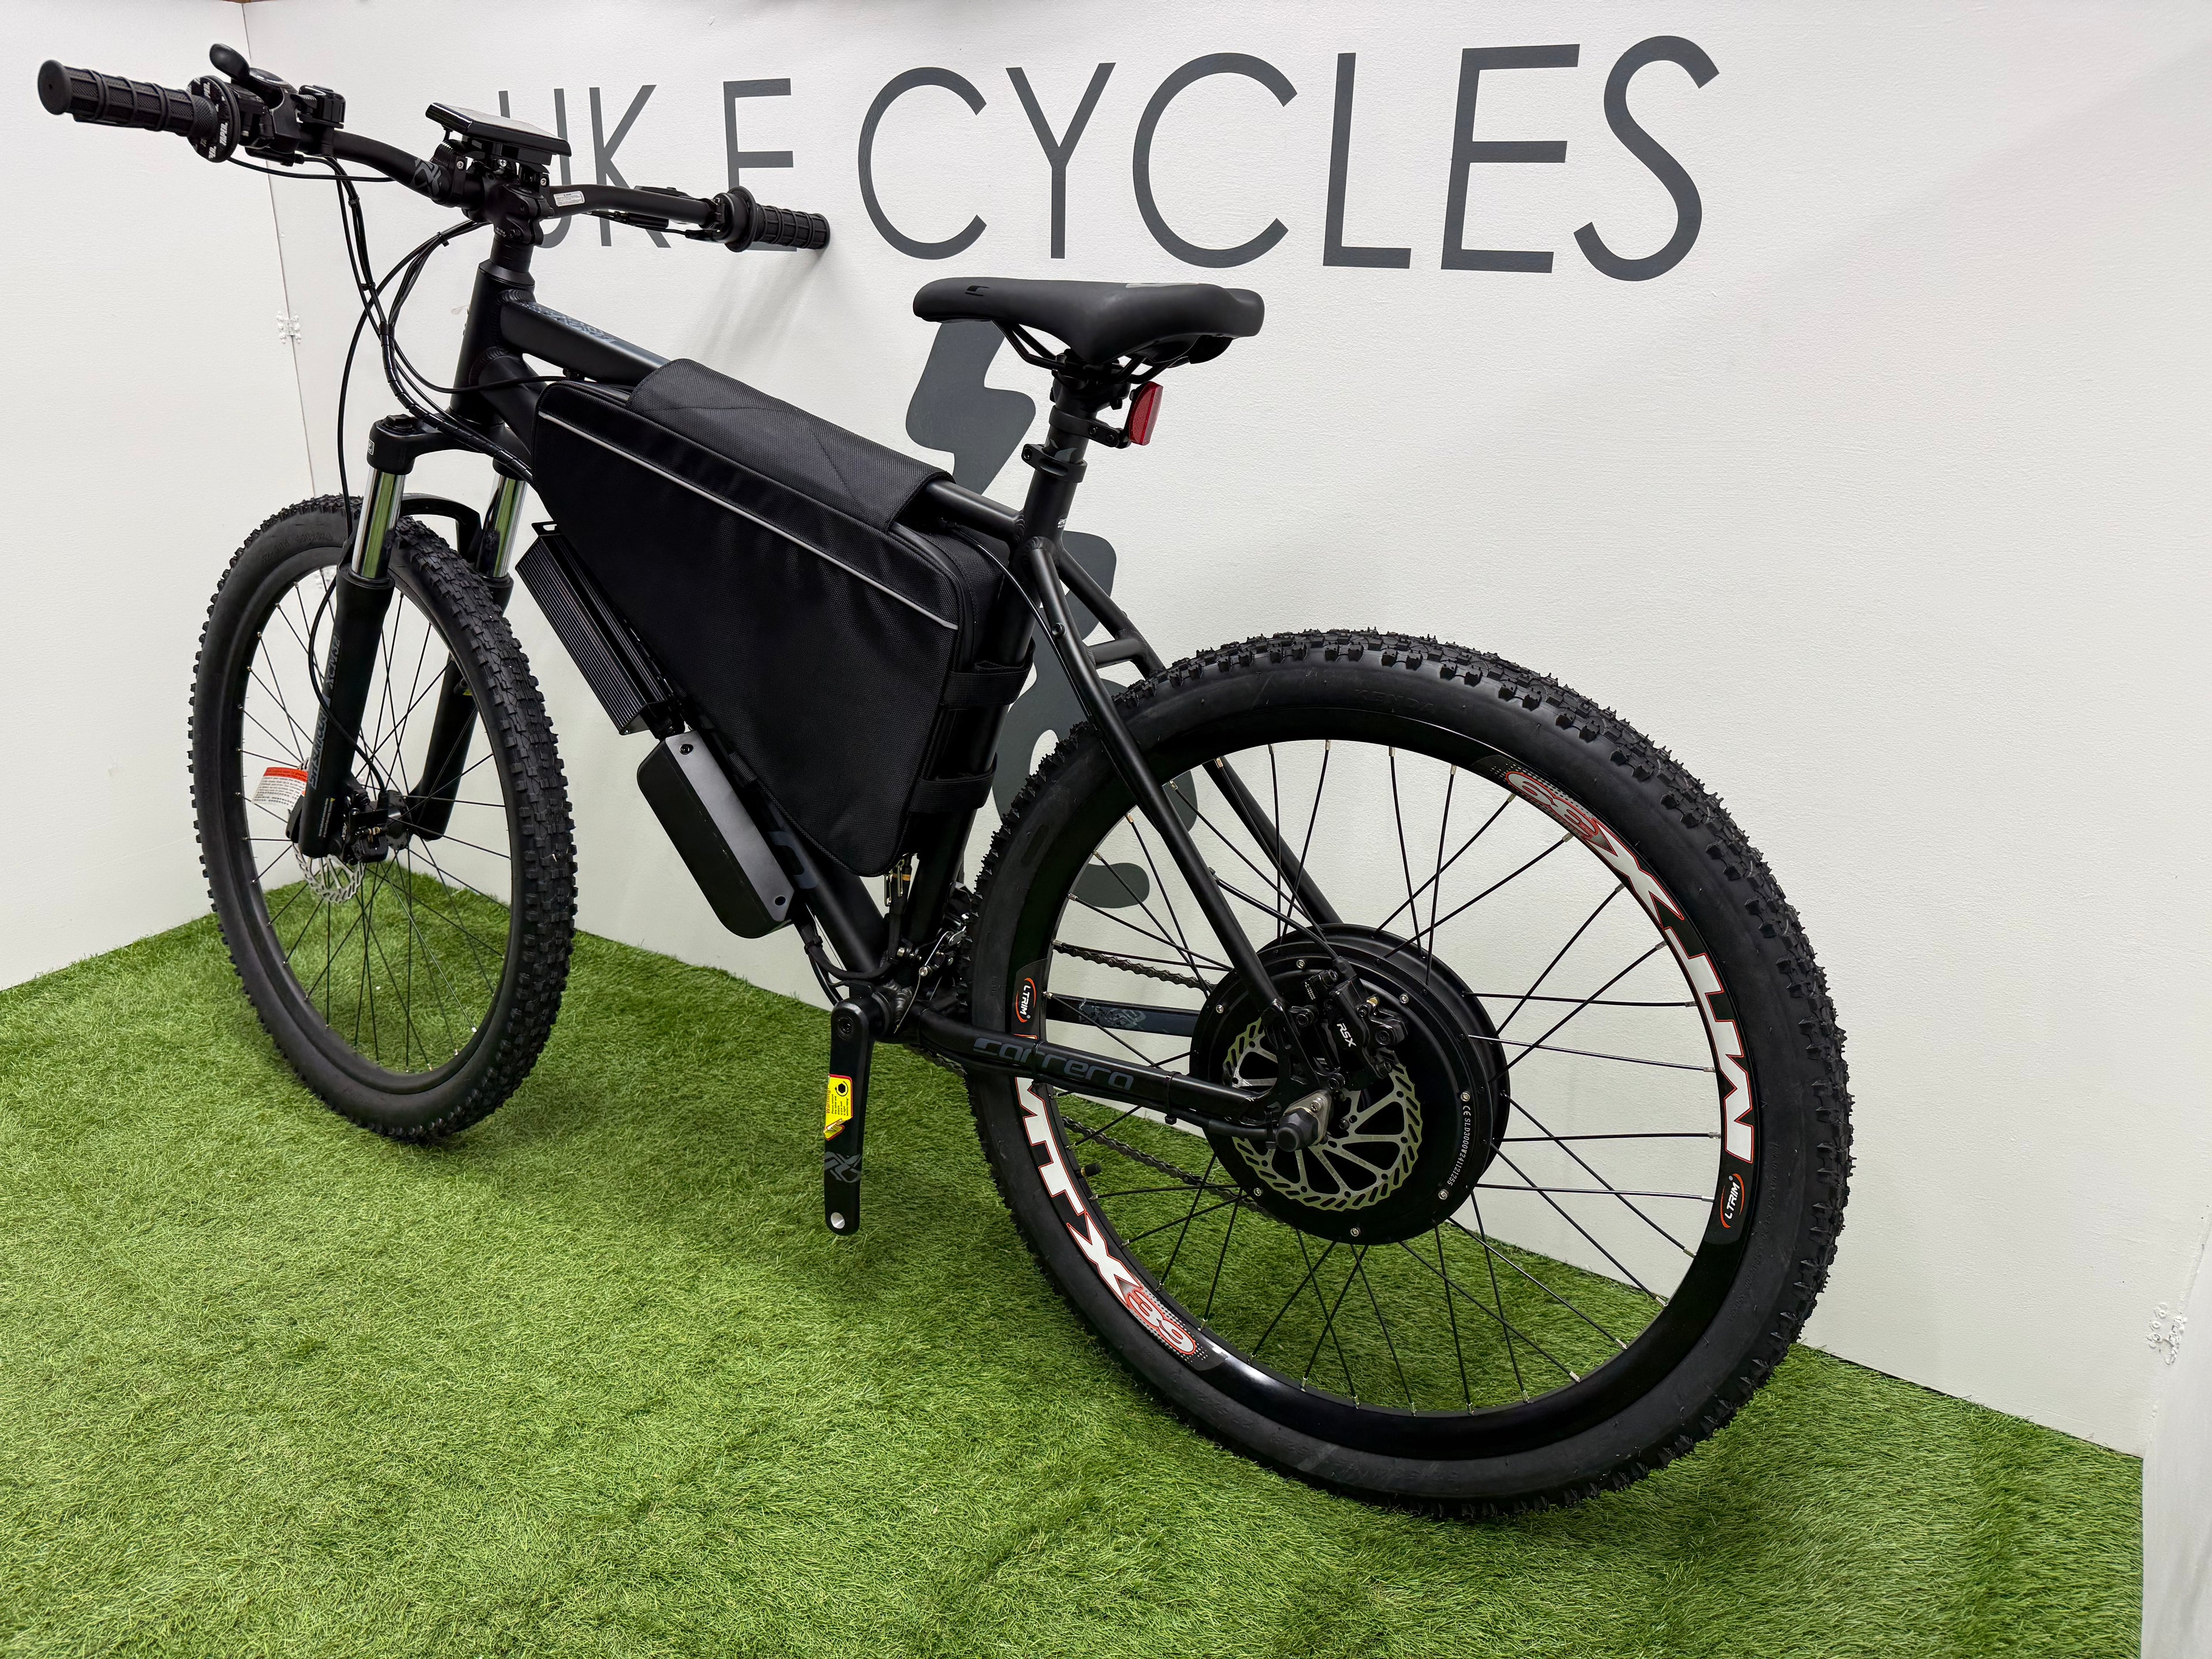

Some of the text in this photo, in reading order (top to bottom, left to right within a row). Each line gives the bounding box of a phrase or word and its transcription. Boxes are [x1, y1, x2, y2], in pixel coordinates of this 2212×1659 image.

[858, 35, 1719, 282] CYCLES
[325, 635, 342, 690] XCM32
[1336, 1022, 1357, 1047] RSX
